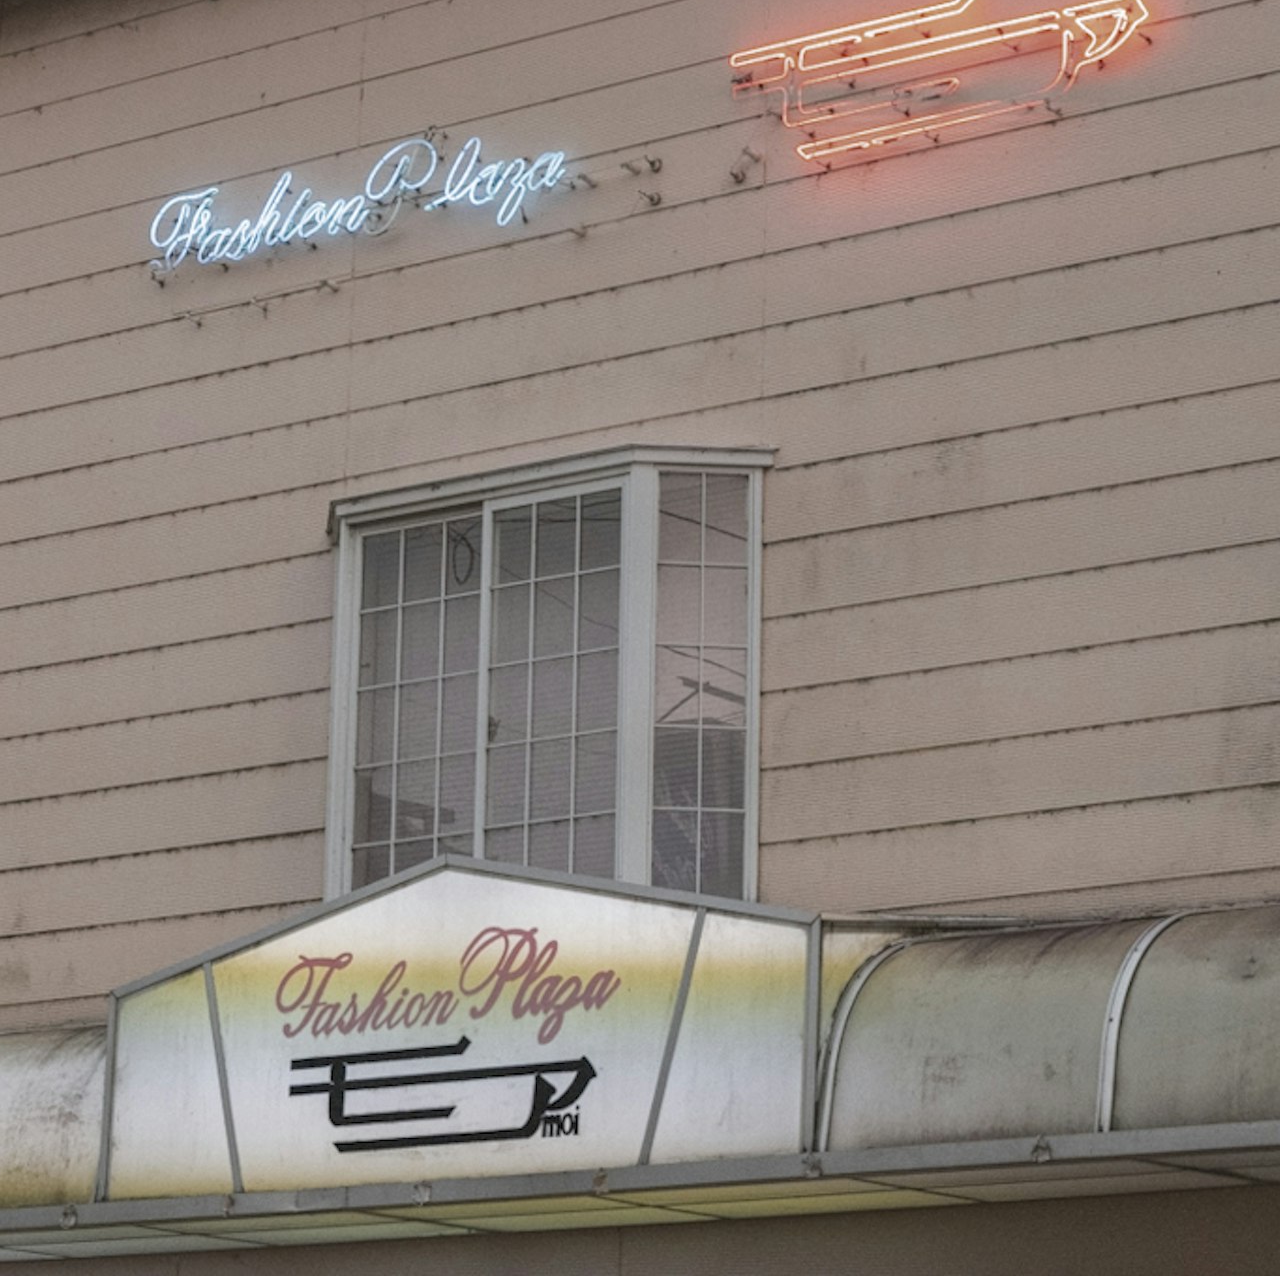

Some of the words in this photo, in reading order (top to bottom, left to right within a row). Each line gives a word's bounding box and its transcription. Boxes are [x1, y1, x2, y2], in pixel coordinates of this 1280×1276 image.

[150, 171, 369, 275] Fashion
[365, 137, 566, 237] Plaza
[275, 952, 459, 1039] Fashion
[459, 927, 620, 1044] Plaza
[541, 1105, 580, 1138] moi
